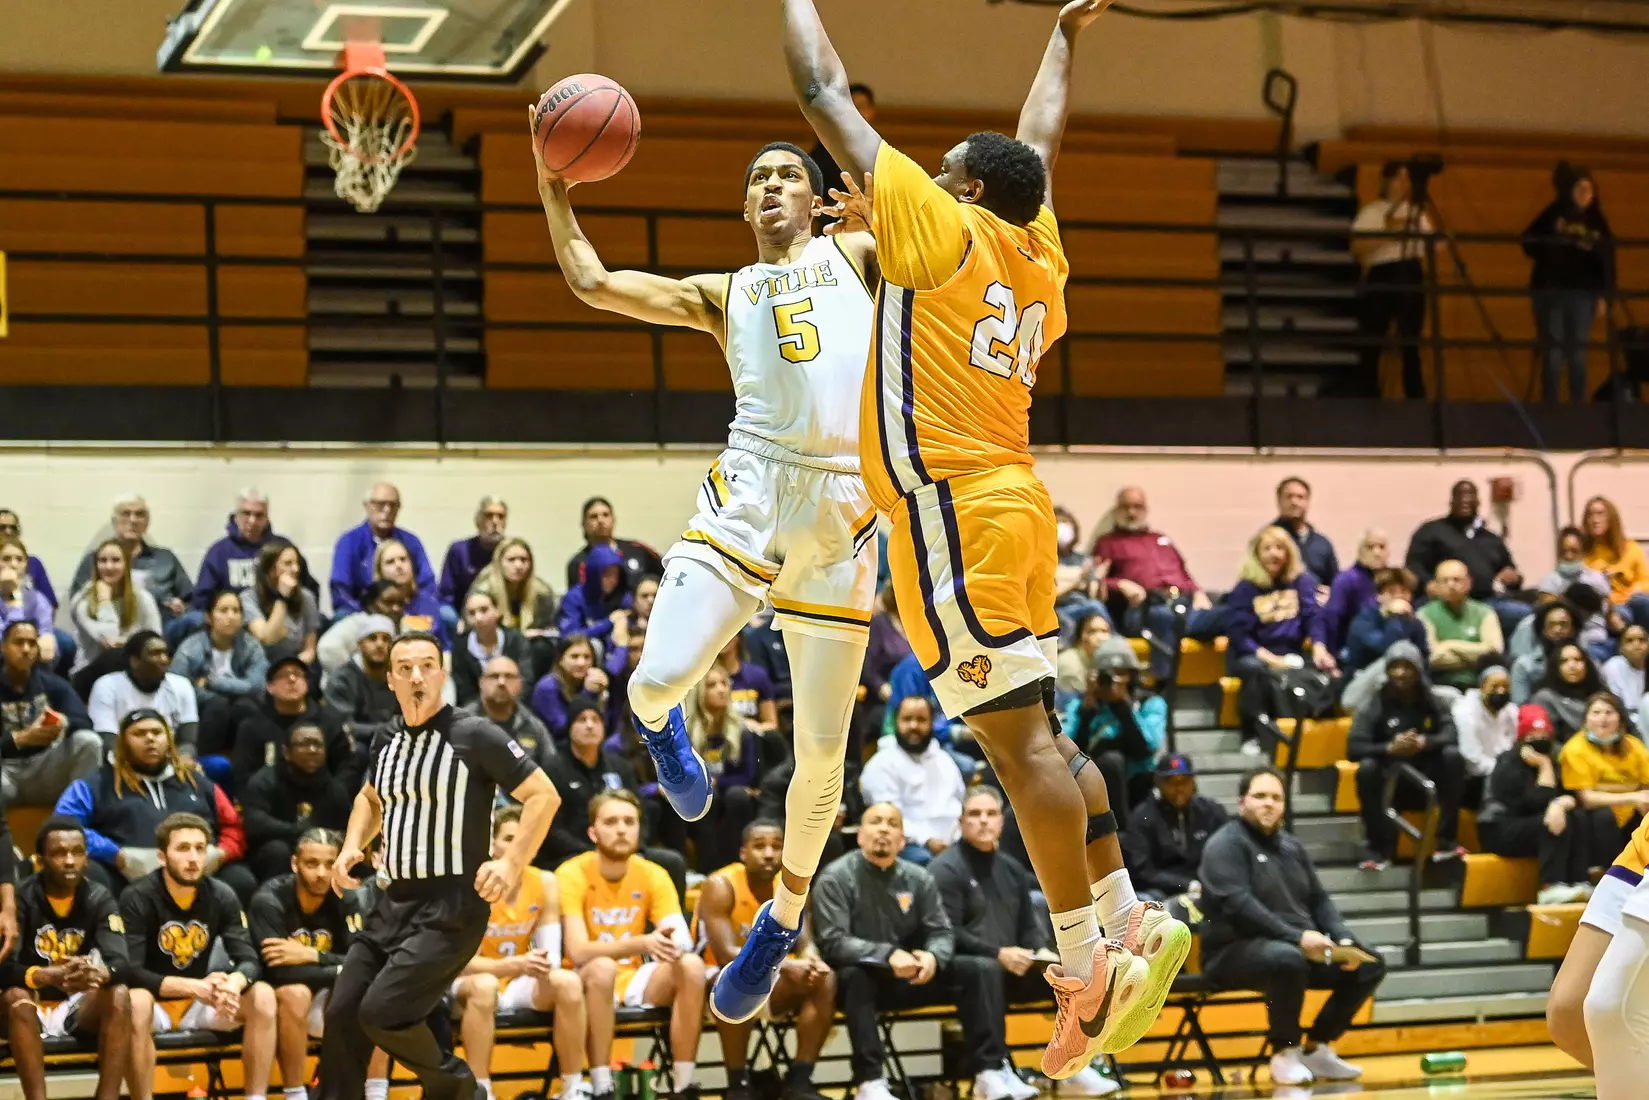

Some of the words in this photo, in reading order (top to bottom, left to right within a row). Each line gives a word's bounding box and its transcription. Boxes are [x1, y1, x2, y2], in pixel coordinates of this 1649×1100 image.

[741, 259, 838, 306] VILLE
[772, 297, 822, 364] 5
[968, 279, 1048, 389] 20
